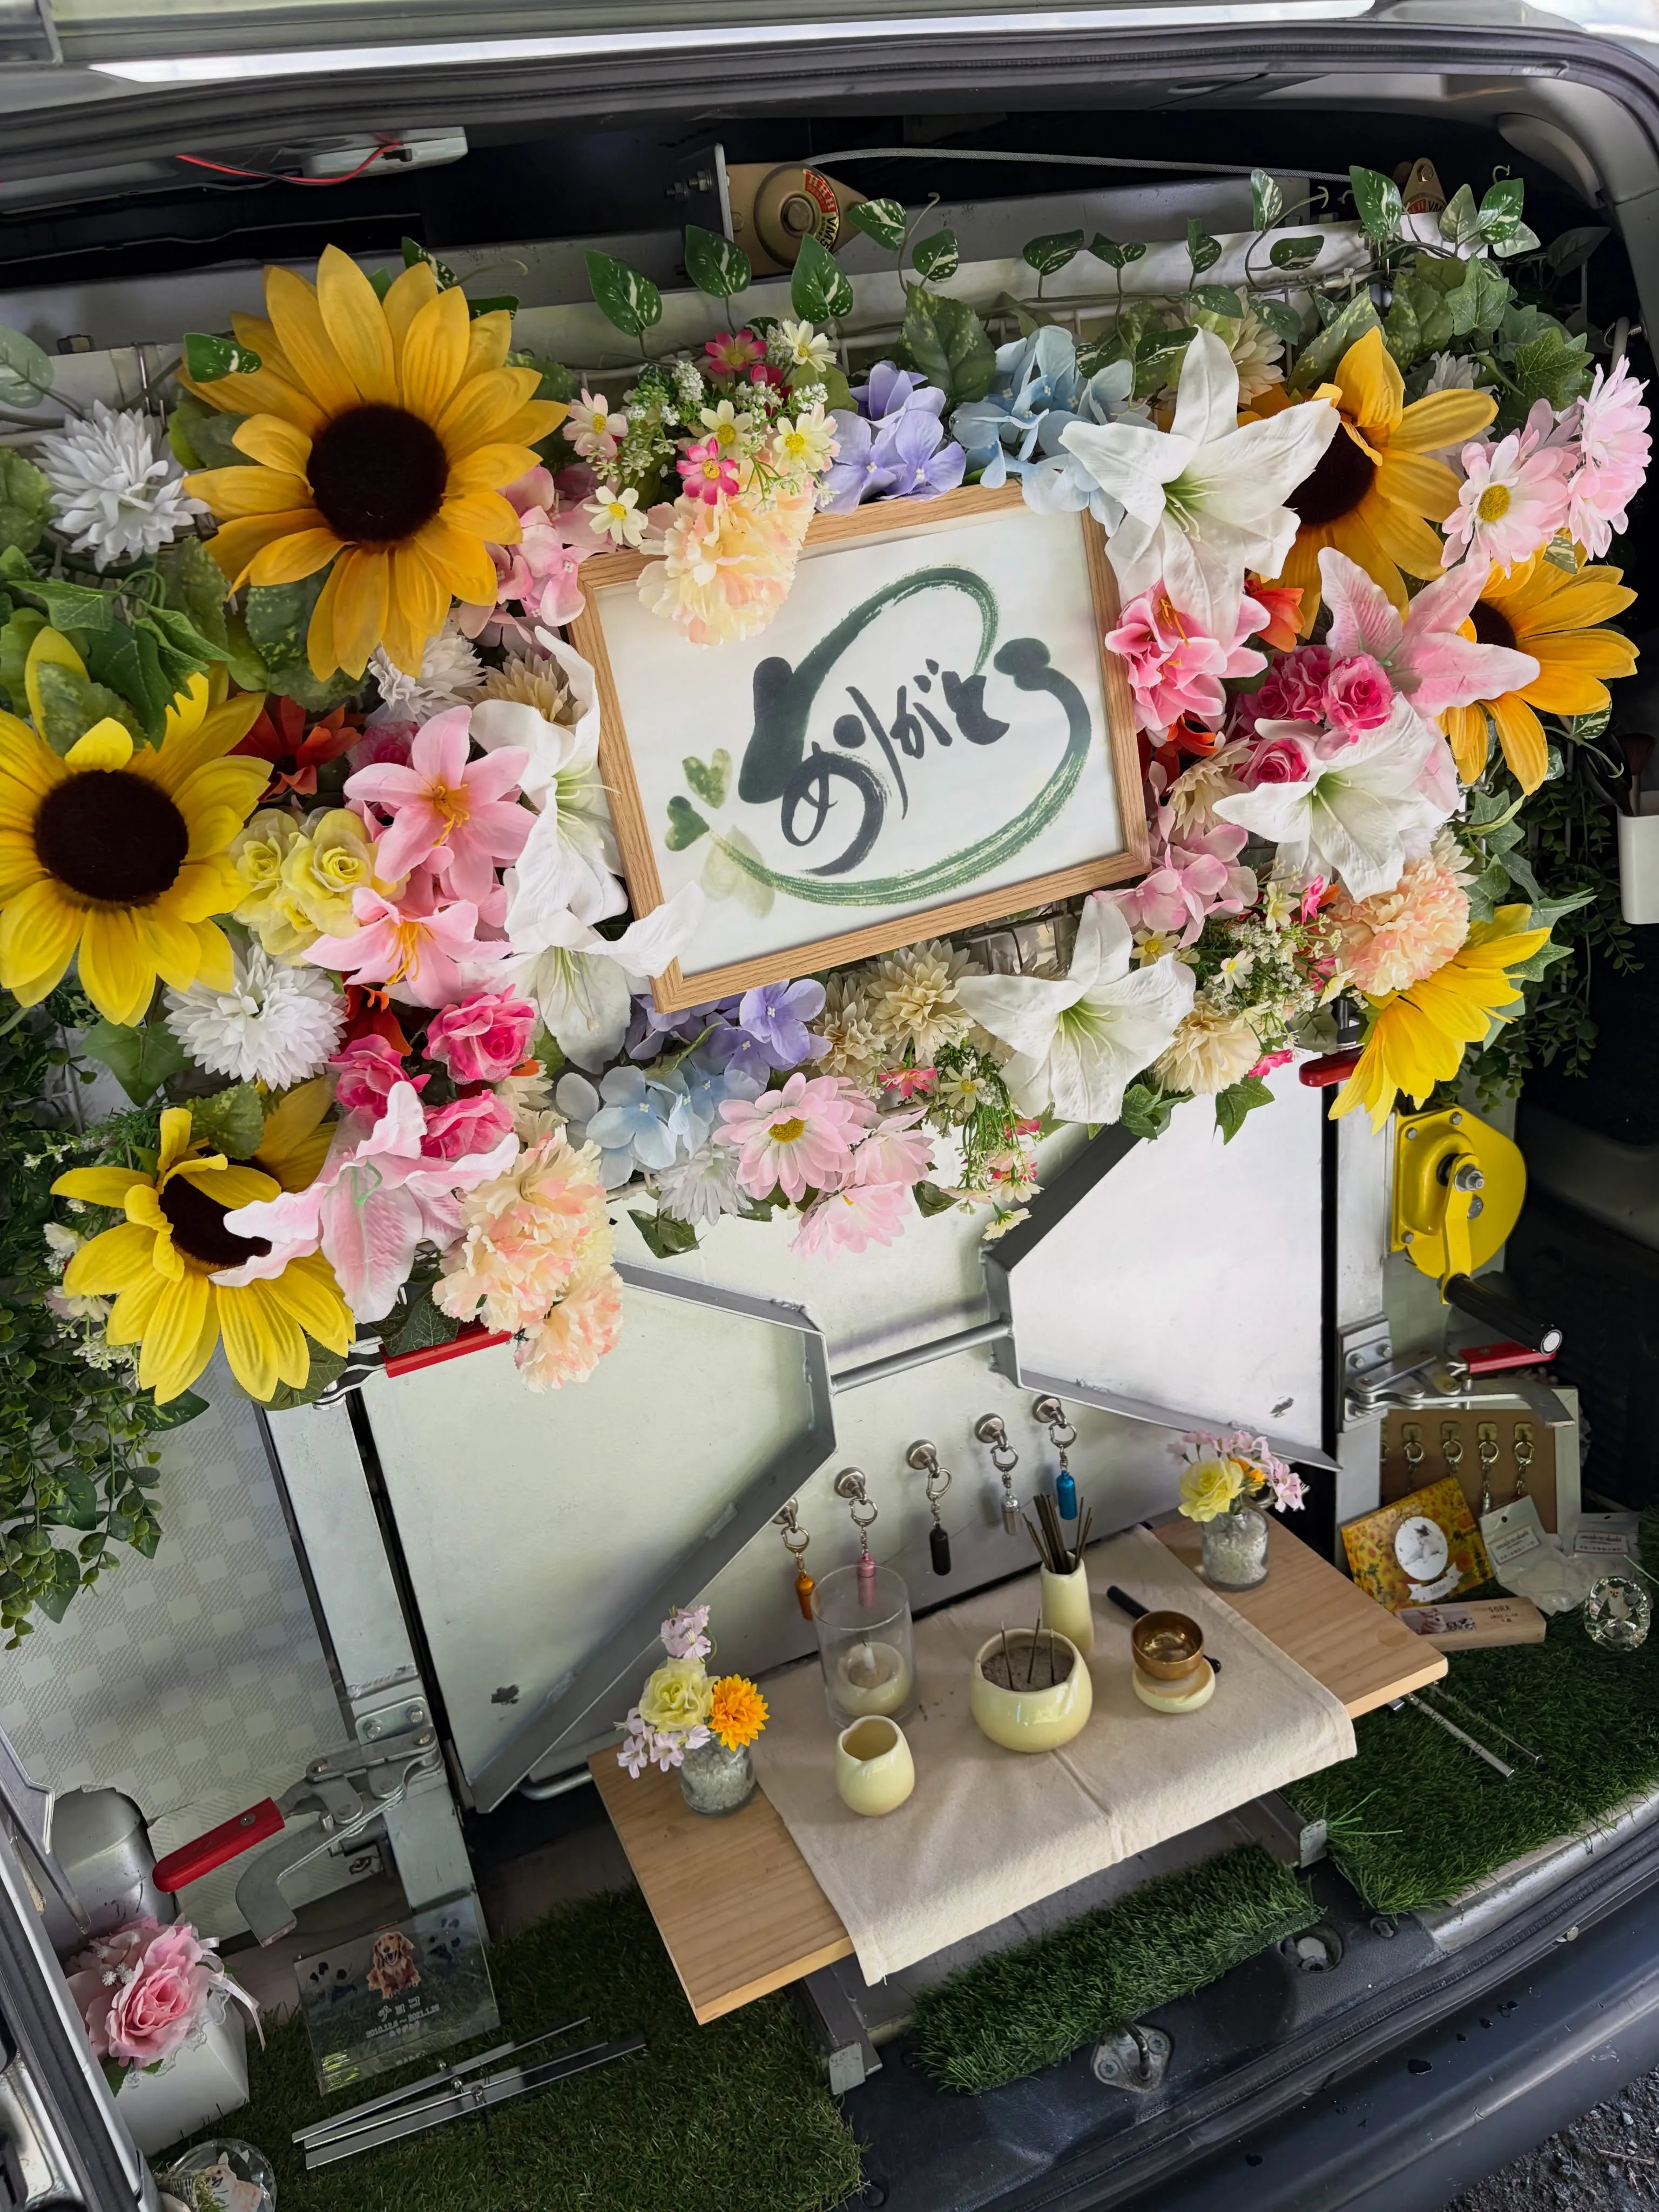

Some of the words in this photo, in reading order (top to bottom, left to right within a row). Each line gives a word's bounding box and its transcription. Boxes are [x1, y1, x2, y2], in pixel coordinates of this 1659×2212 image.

[809, 176, 835, 210] HHH
[378, 1996, 420, 2022] チョコ
